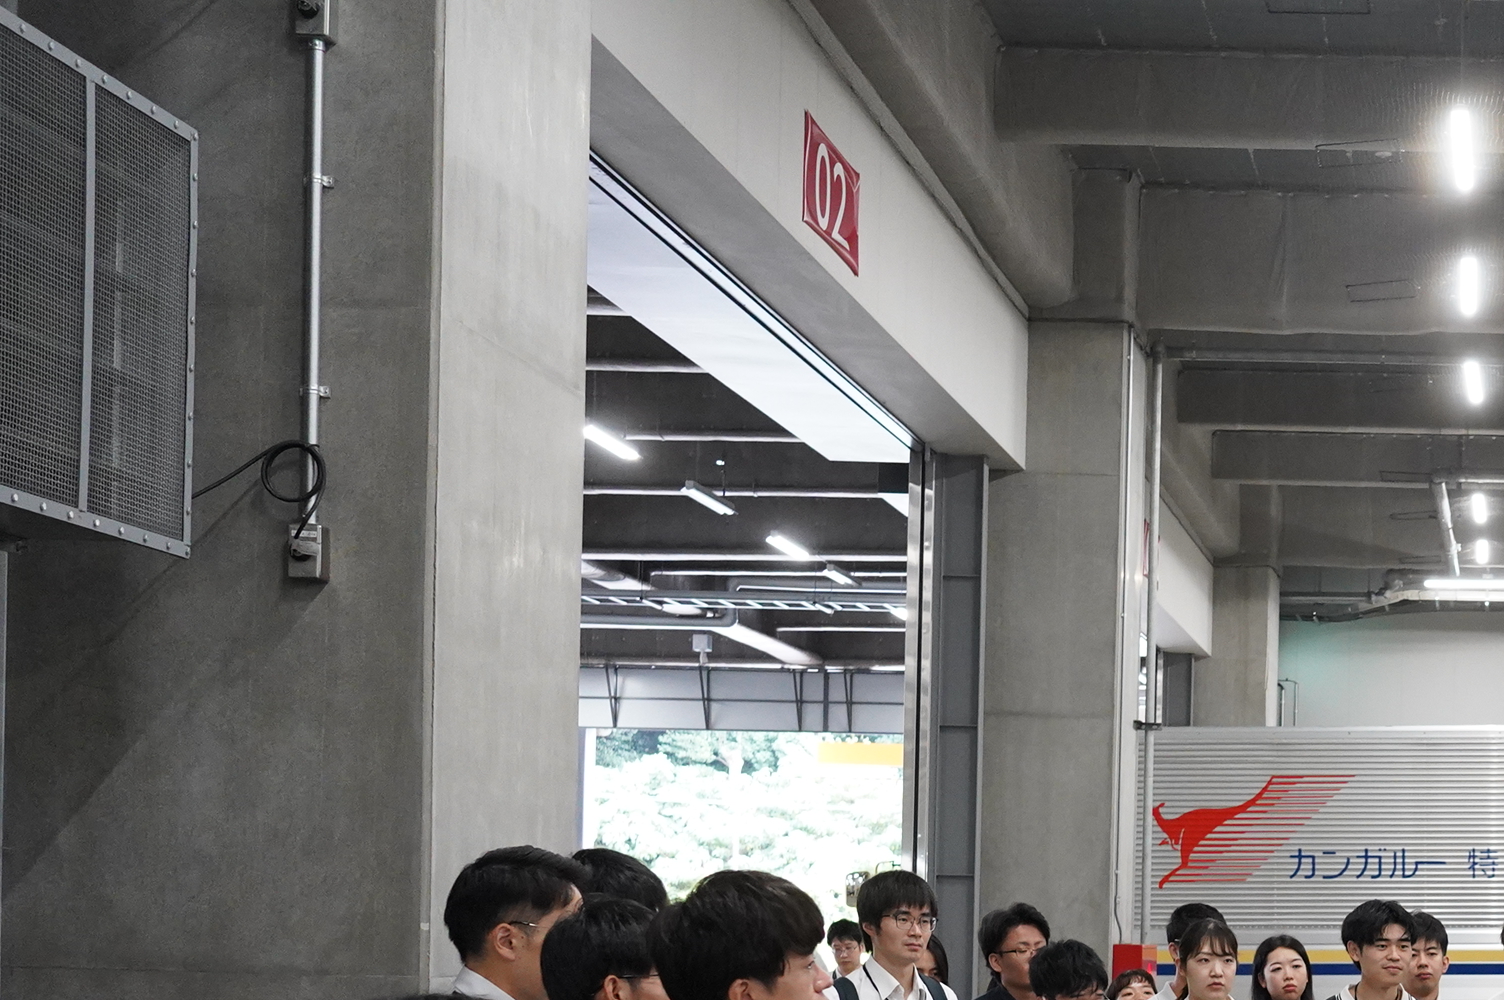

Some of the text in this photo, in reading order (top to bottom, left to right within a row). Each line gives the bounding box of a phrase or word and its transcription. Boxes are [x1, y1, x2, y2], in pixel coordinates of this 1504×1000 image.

[815, 143, 850, 251] 02
[1289, 848, 1447, 879] カンガルー
